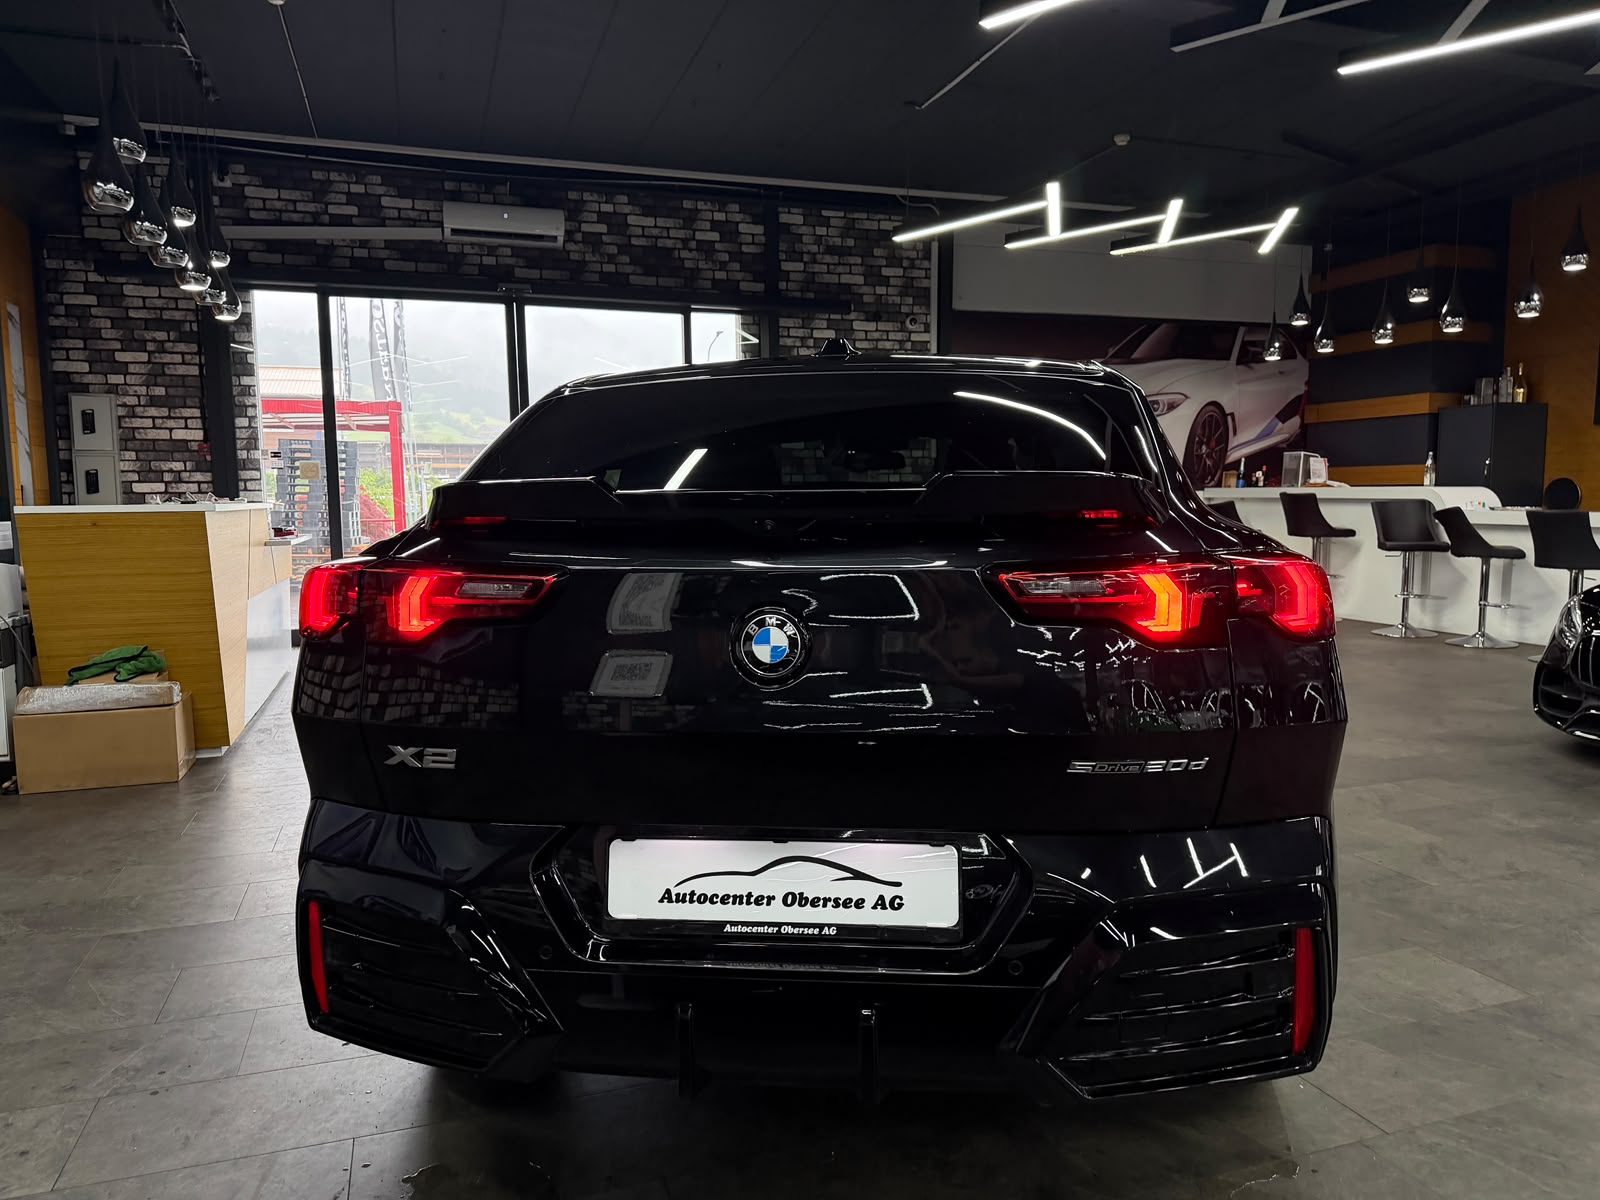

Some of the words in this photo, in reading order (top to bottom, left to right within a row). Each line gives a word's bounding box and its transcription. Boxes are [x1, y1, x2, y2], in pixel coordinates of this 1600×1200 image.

[748, 617, 796, 636] BMW
[384, 744, 457, 769] X2
[658, 888, 776, 907] Autocenter
[782, 892, 866, 910] Obersee
[871, 894, 905, 911] AG
[724, 923, 779, 934] Autocenter
[780, 925, 820, 935] Obersee
[821, 926, 837, 935] AG
